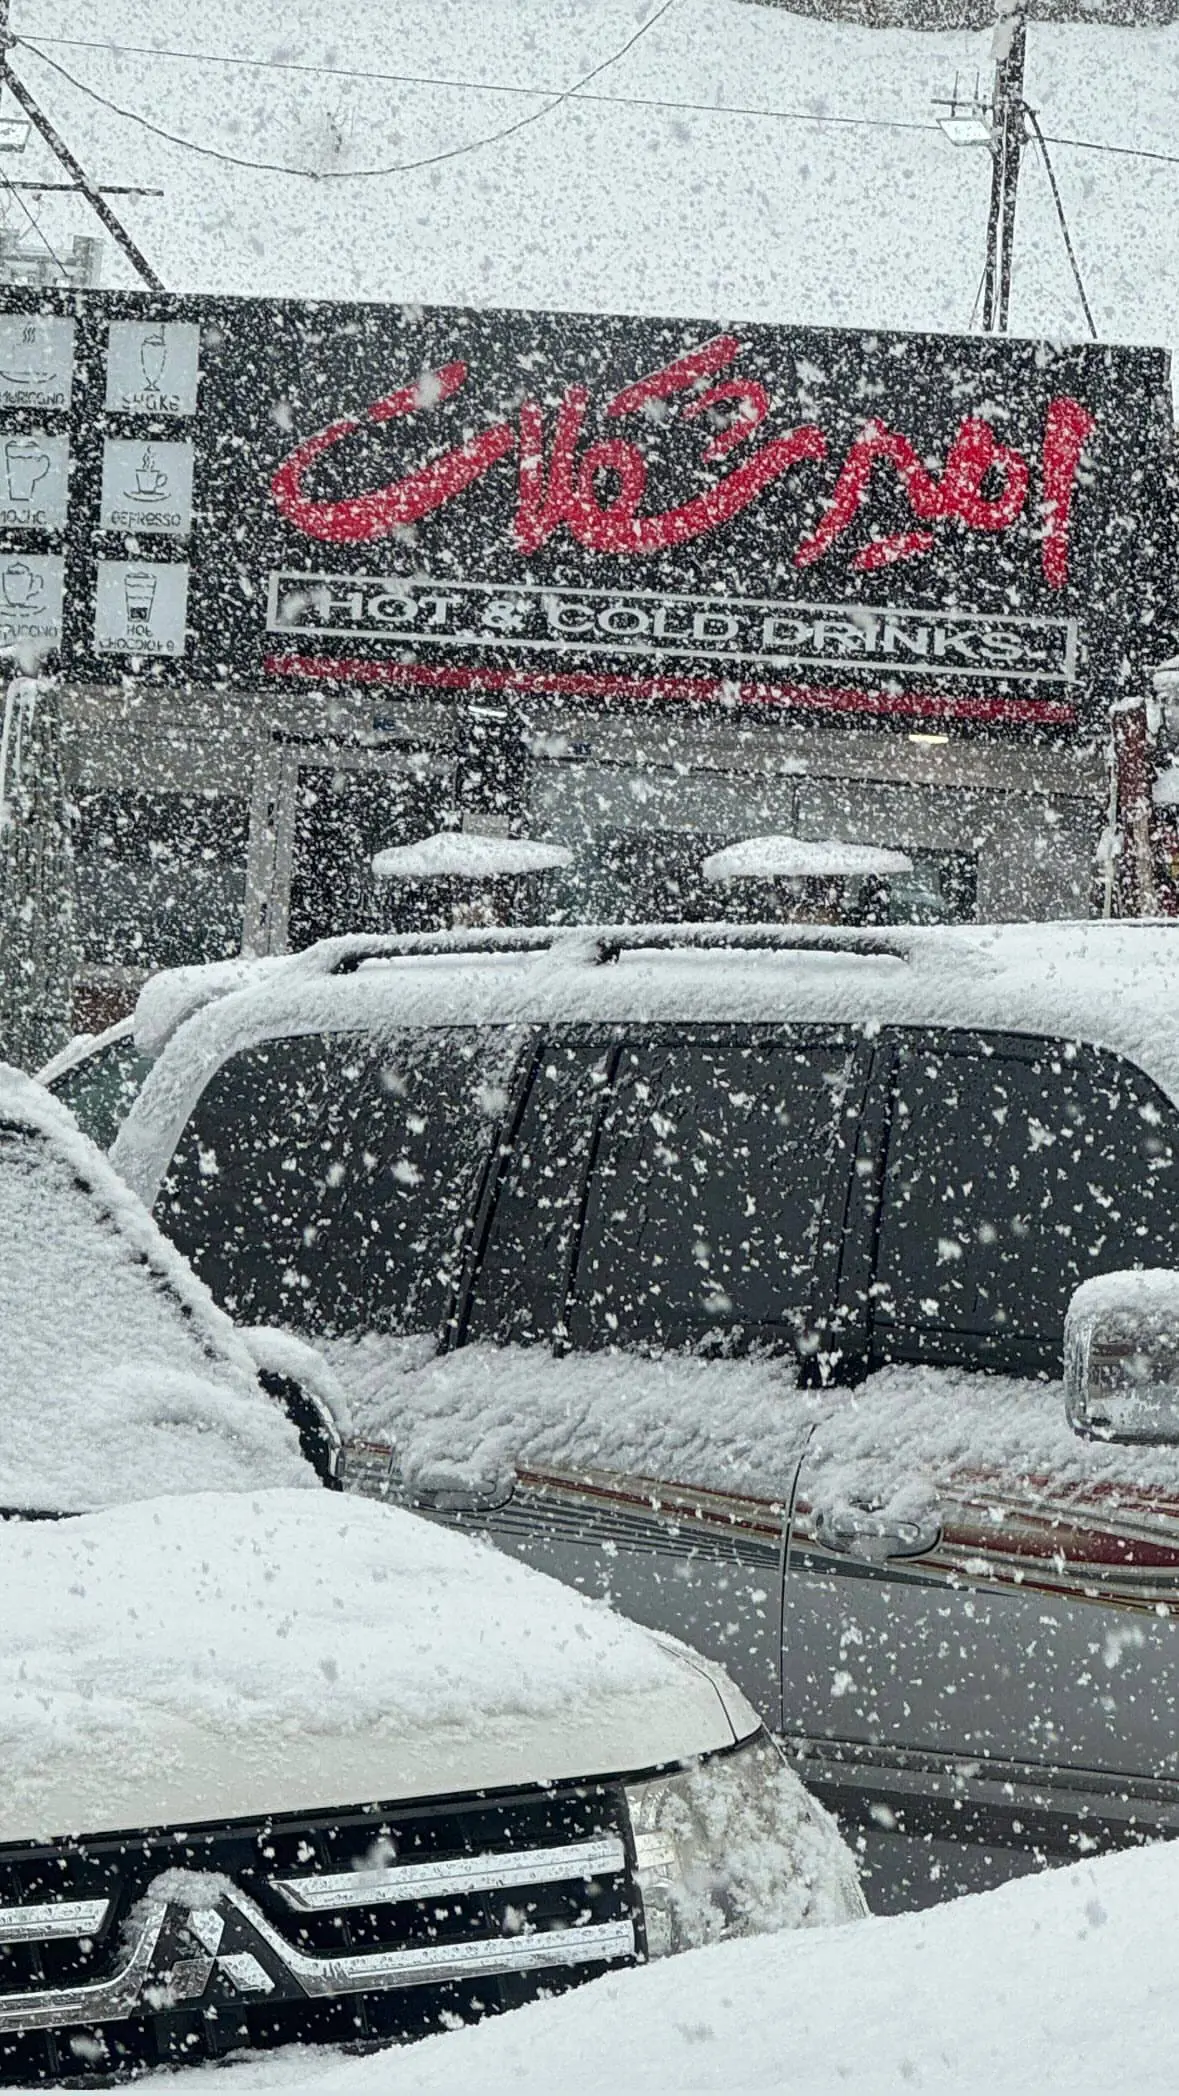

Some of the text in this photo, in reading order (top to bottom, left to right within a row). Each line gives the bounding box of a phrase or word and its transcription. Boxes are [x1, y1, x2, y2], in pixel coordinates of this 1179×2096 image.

[318, 591, 1024, 661] HOT & COLD DRINKS
